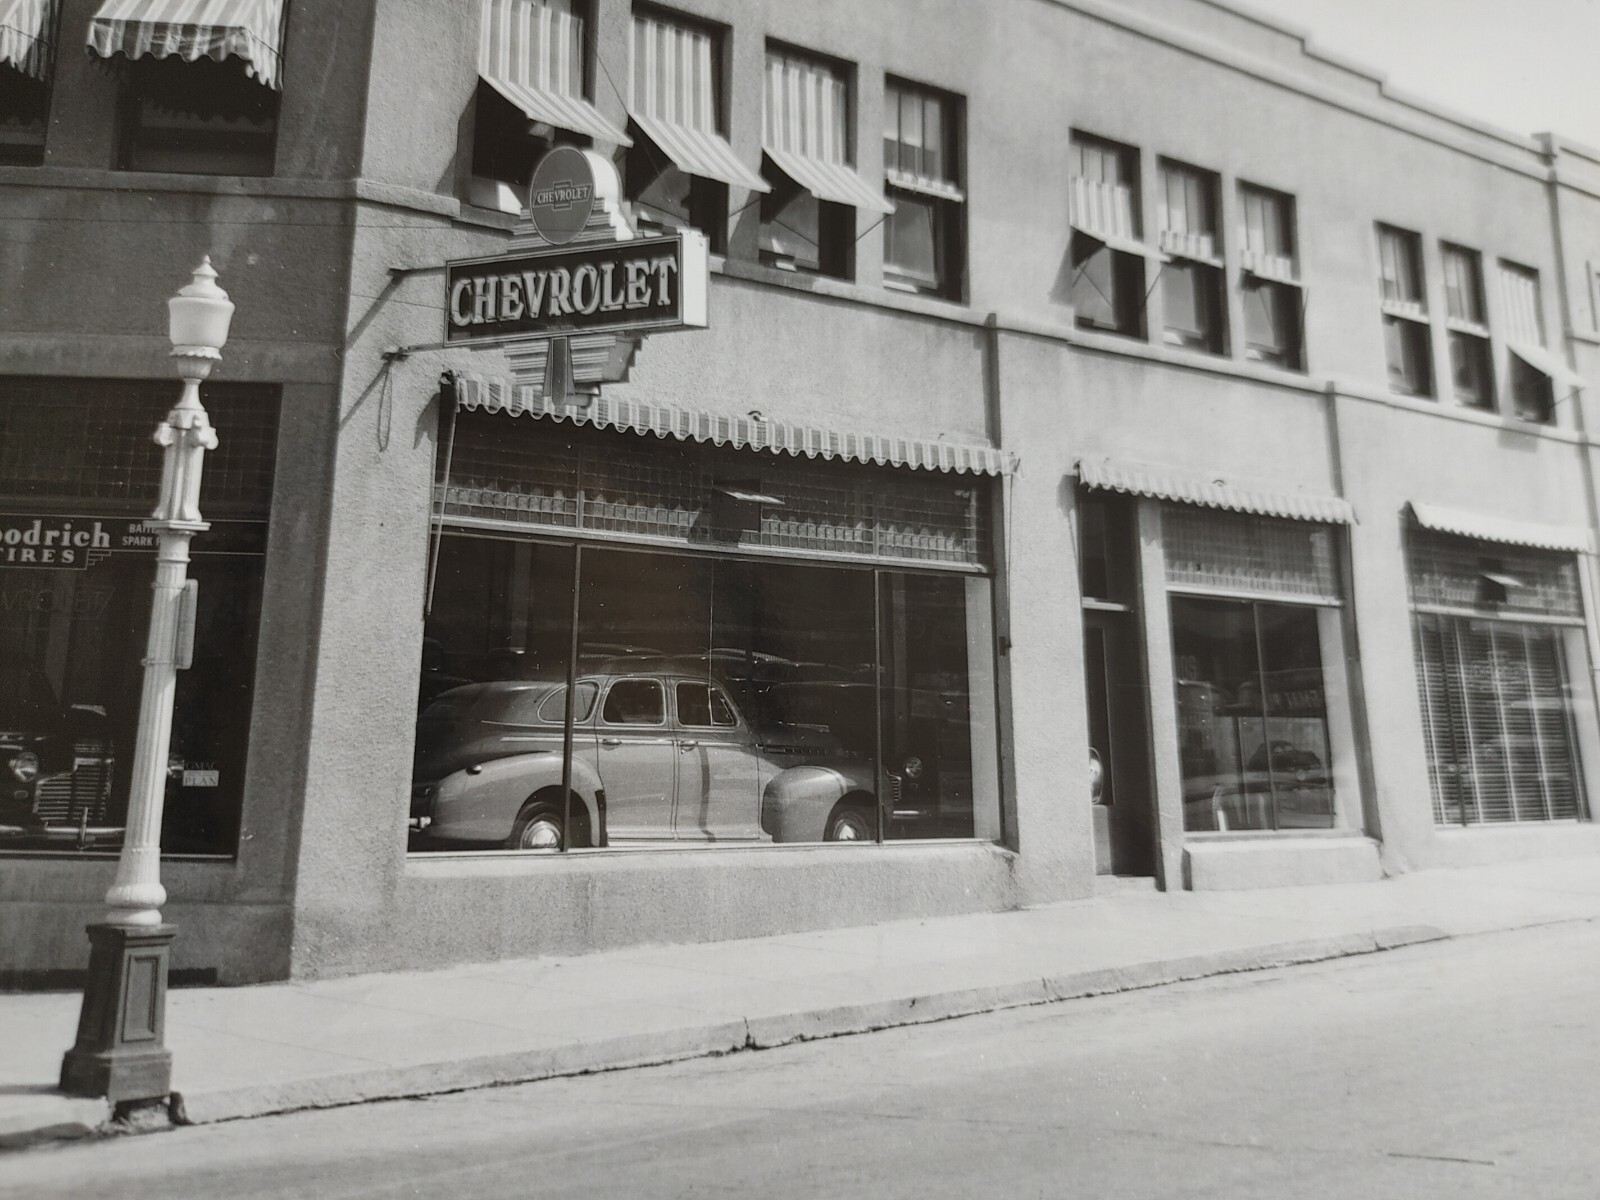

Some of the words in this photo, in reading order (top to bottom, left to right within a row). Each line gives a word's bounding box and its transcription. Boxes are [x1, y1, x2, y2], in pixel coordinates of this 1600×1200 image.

[537, 187, 588, 204] CHEVROLET
[449, 256, 678, 327] CHEVROLET
[0, 519, 111, 548] odrich
[122, 535, 153, 546] SPARK
[0, 547, 75, 564] IRES
[185, 776, 217, 785] PLAN
